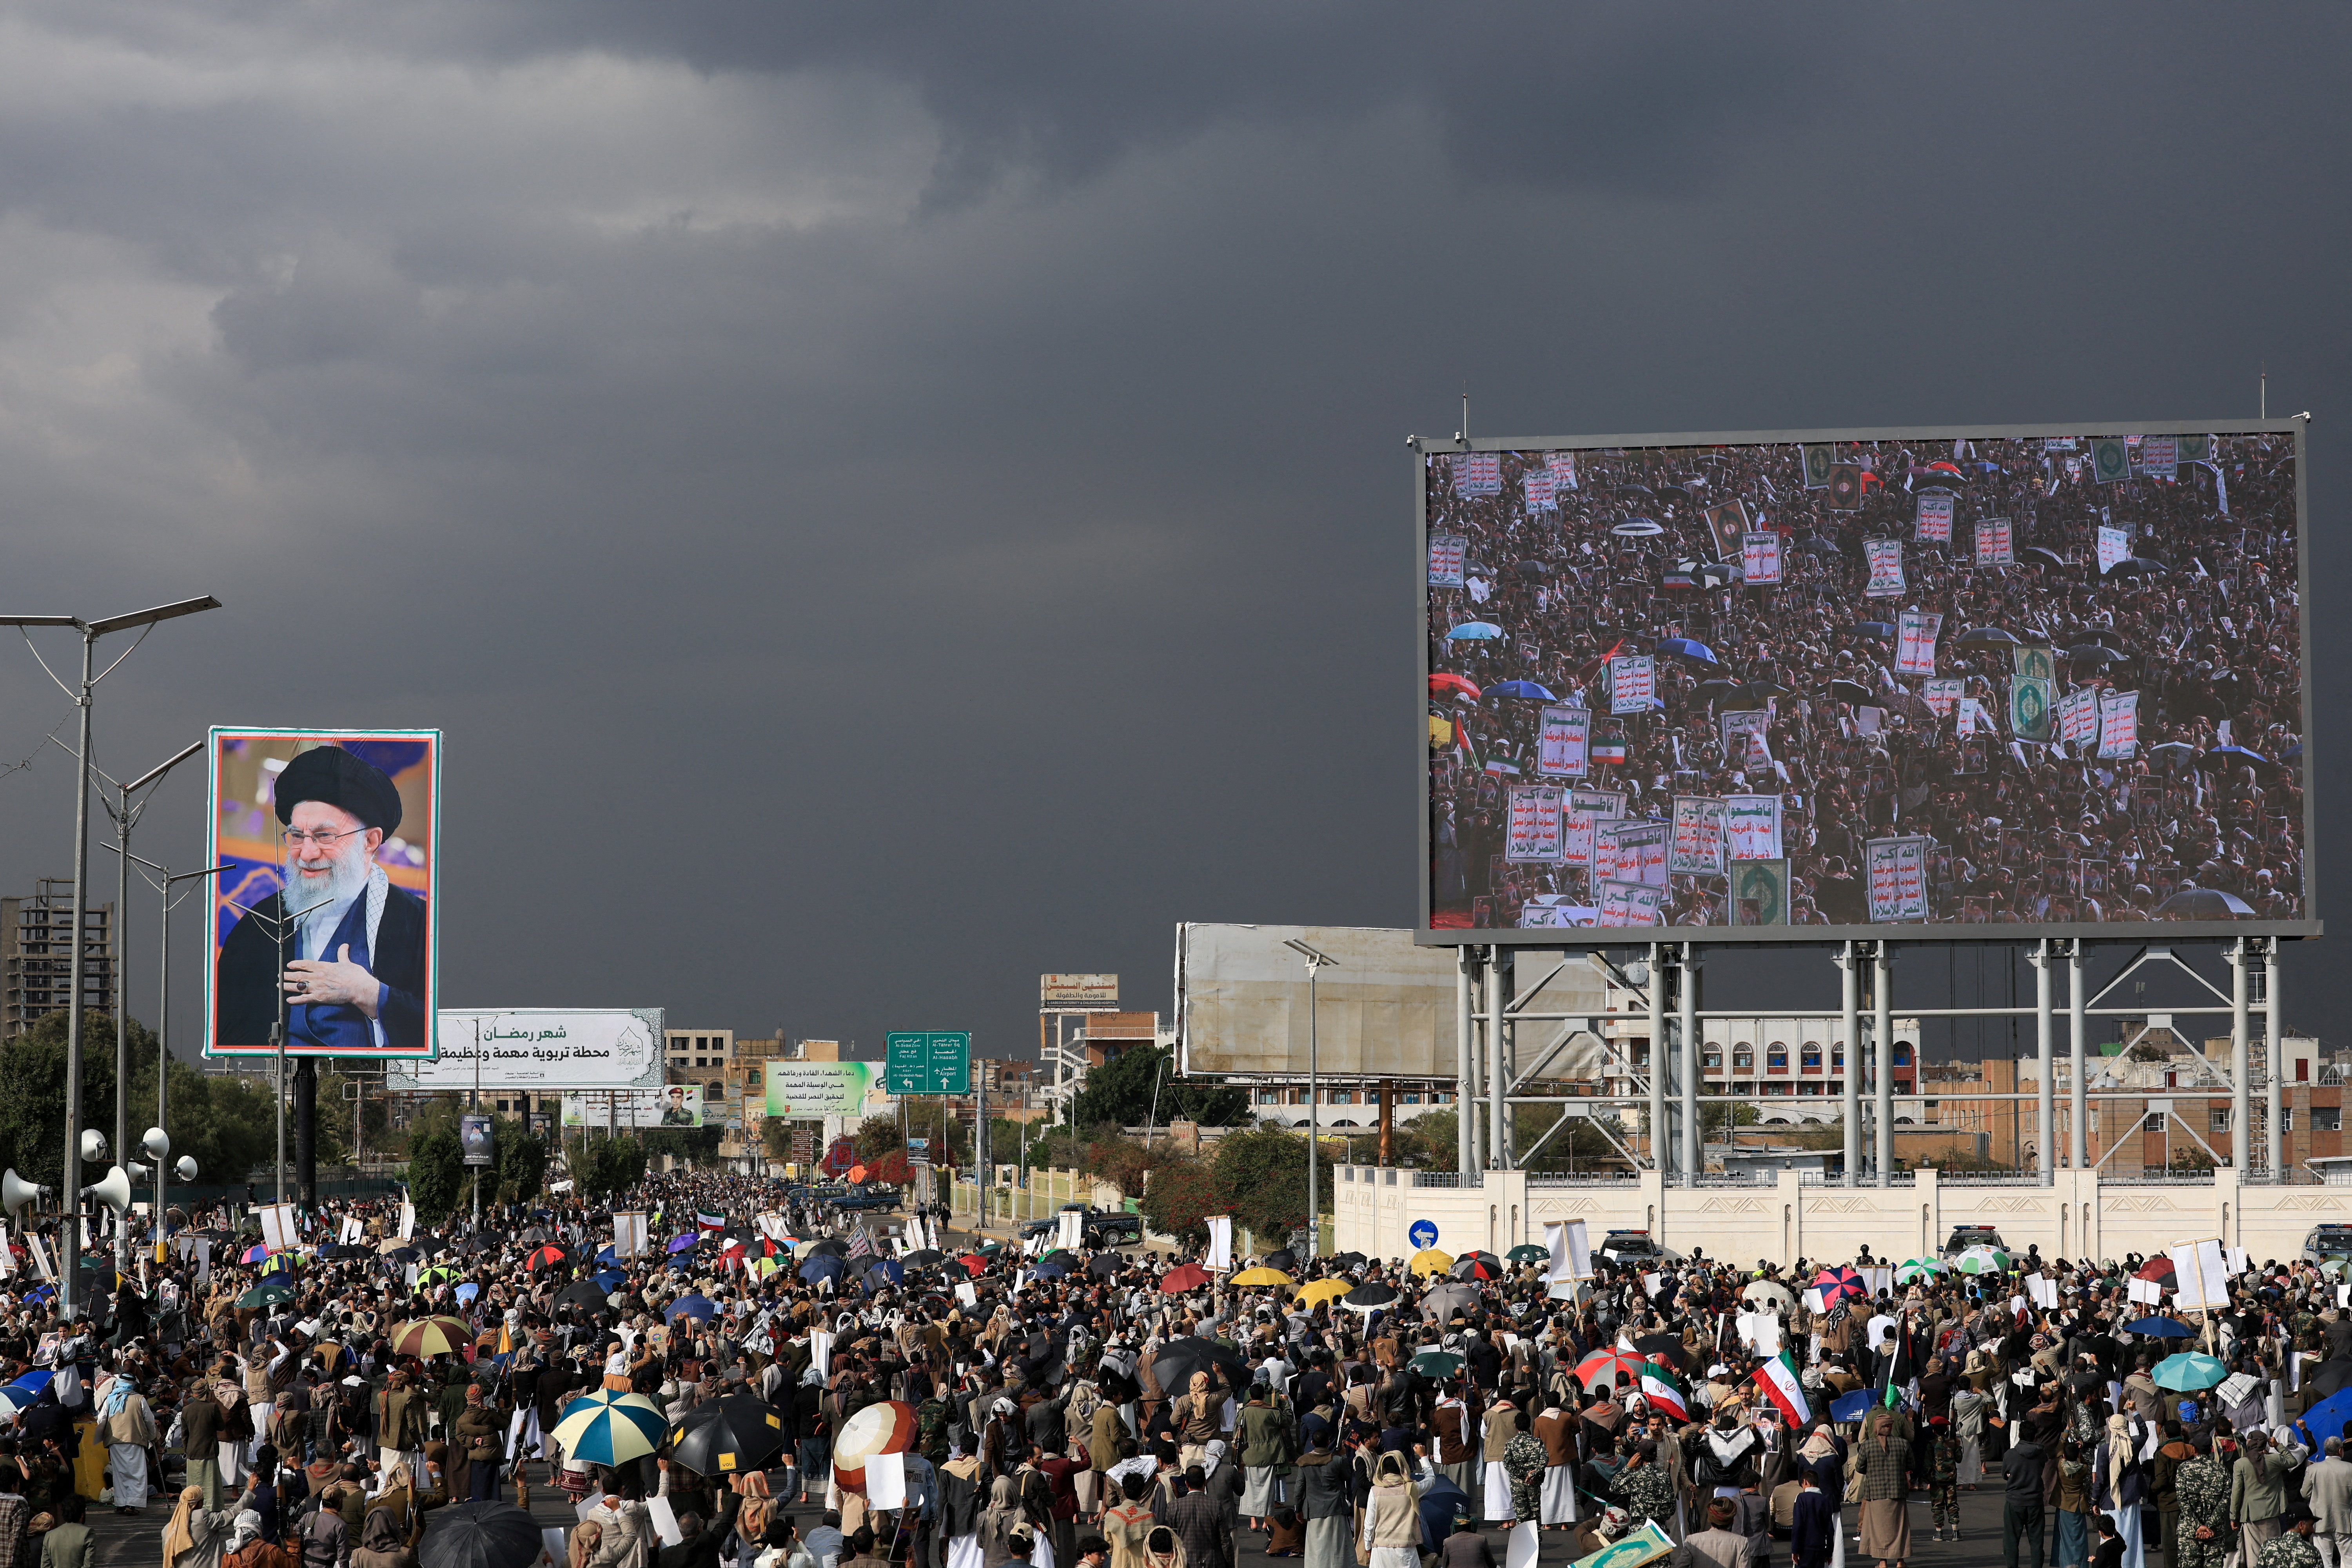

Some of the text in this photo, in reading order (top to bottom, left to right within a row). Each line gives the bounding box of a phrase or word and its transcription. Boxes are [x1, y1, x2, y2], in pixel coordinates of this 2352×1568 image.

[1745, 534, 1774, 548] قاطعوا
[1615, 658, 1650, 672] الله أكبر
[1546, 713, 1585, 727] قاطعوا
[1514, 787, 1560, 803] الله أكبر
[1539, 805, 1558, 814] الموت
[1539, 818, 1557, 828] الموت
[1703, 822, 1720, 831] الموت
[1512, 830, 1557, 840] اللعنة على اليهود
[1618, 829, 1661, 852] قاطعوا
[1537, 842, 1557, 855] النصر
[1675, 845, 1692, 854] اليهود
[1873, 844, 1918, 863] الله أكبر
[1644, 851, 1665, 868] البضائع
[1900, 862, 1918, 873] الموت
[1900, 876, 1919, 887] الموت
[1606, 887, 1659, 907] الله أكبر
[1874, 889, 1921, 902] اللعنة على اليهود
[1902, 901, 1923, 917] النصر
[1631, 911, 1655, 921] الموت
[1047, 982, 1116, 991] مستشفى السبعين
[484, 1025, 566, 1042] شهر رمضان
[441, 1046, 610, 1062] محطة تربوية مهمة وعظيمة
